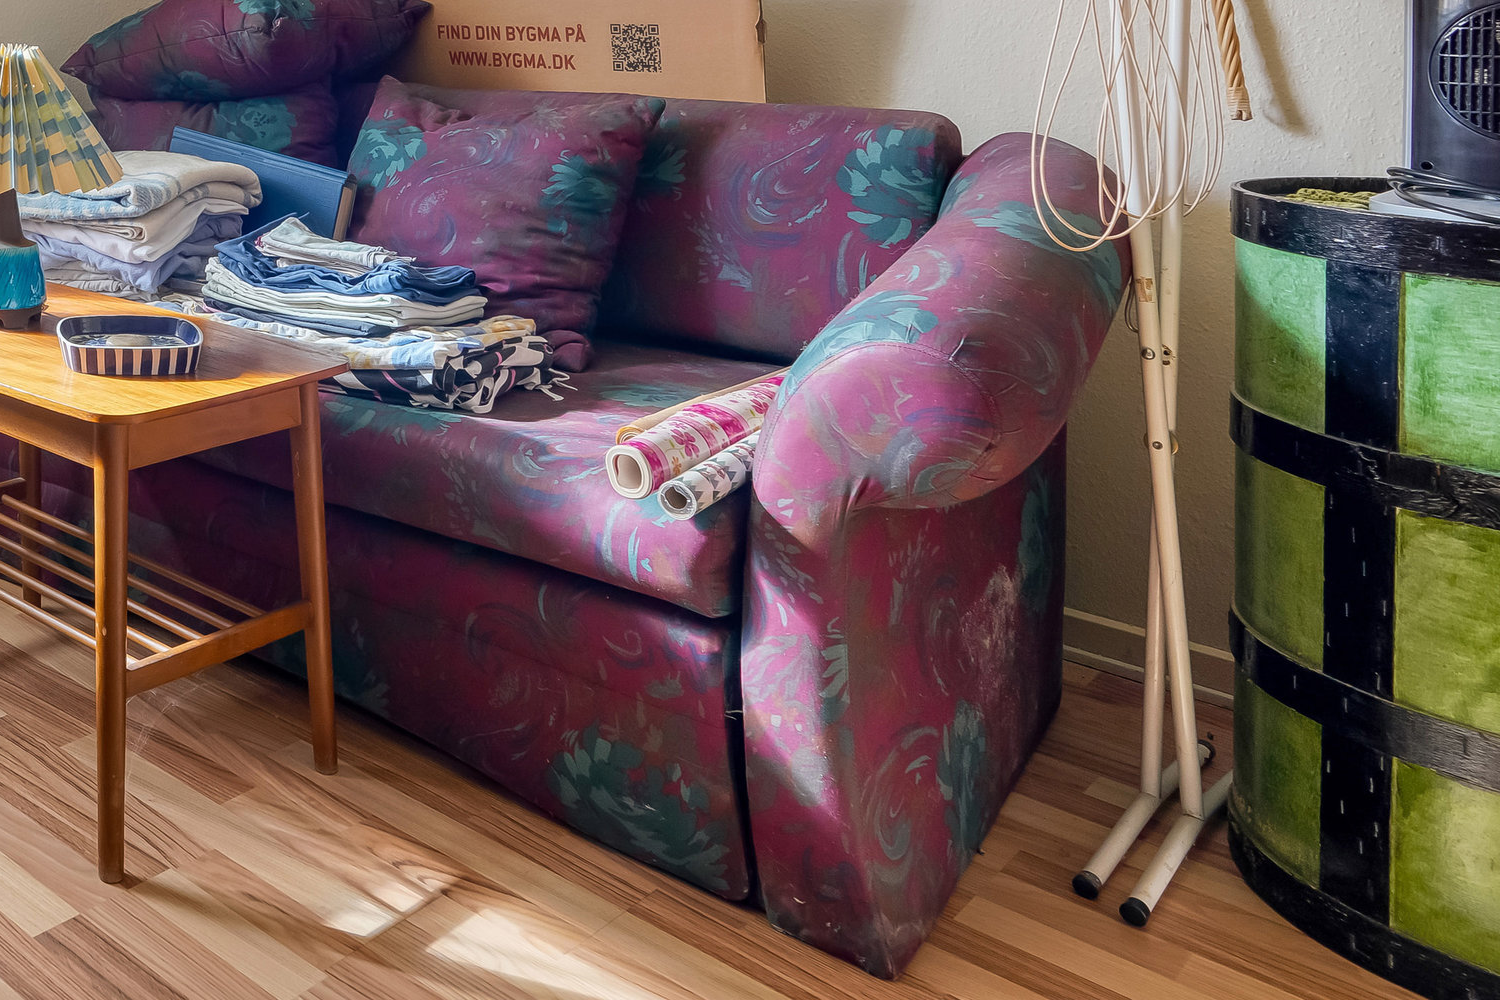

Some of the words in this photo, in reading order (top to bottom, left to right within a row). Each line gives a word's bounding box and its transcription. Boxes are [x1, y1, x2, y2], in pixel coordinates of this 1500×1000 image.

[437, 25, 471, 41] FIND
[475, 26, 501, 41] DIN
[506, 26, 561, 43] BYGMA
[565, 23, 586, 43] PÅ
[449, 51, 576, 71] WWW.BYGMA.DK
